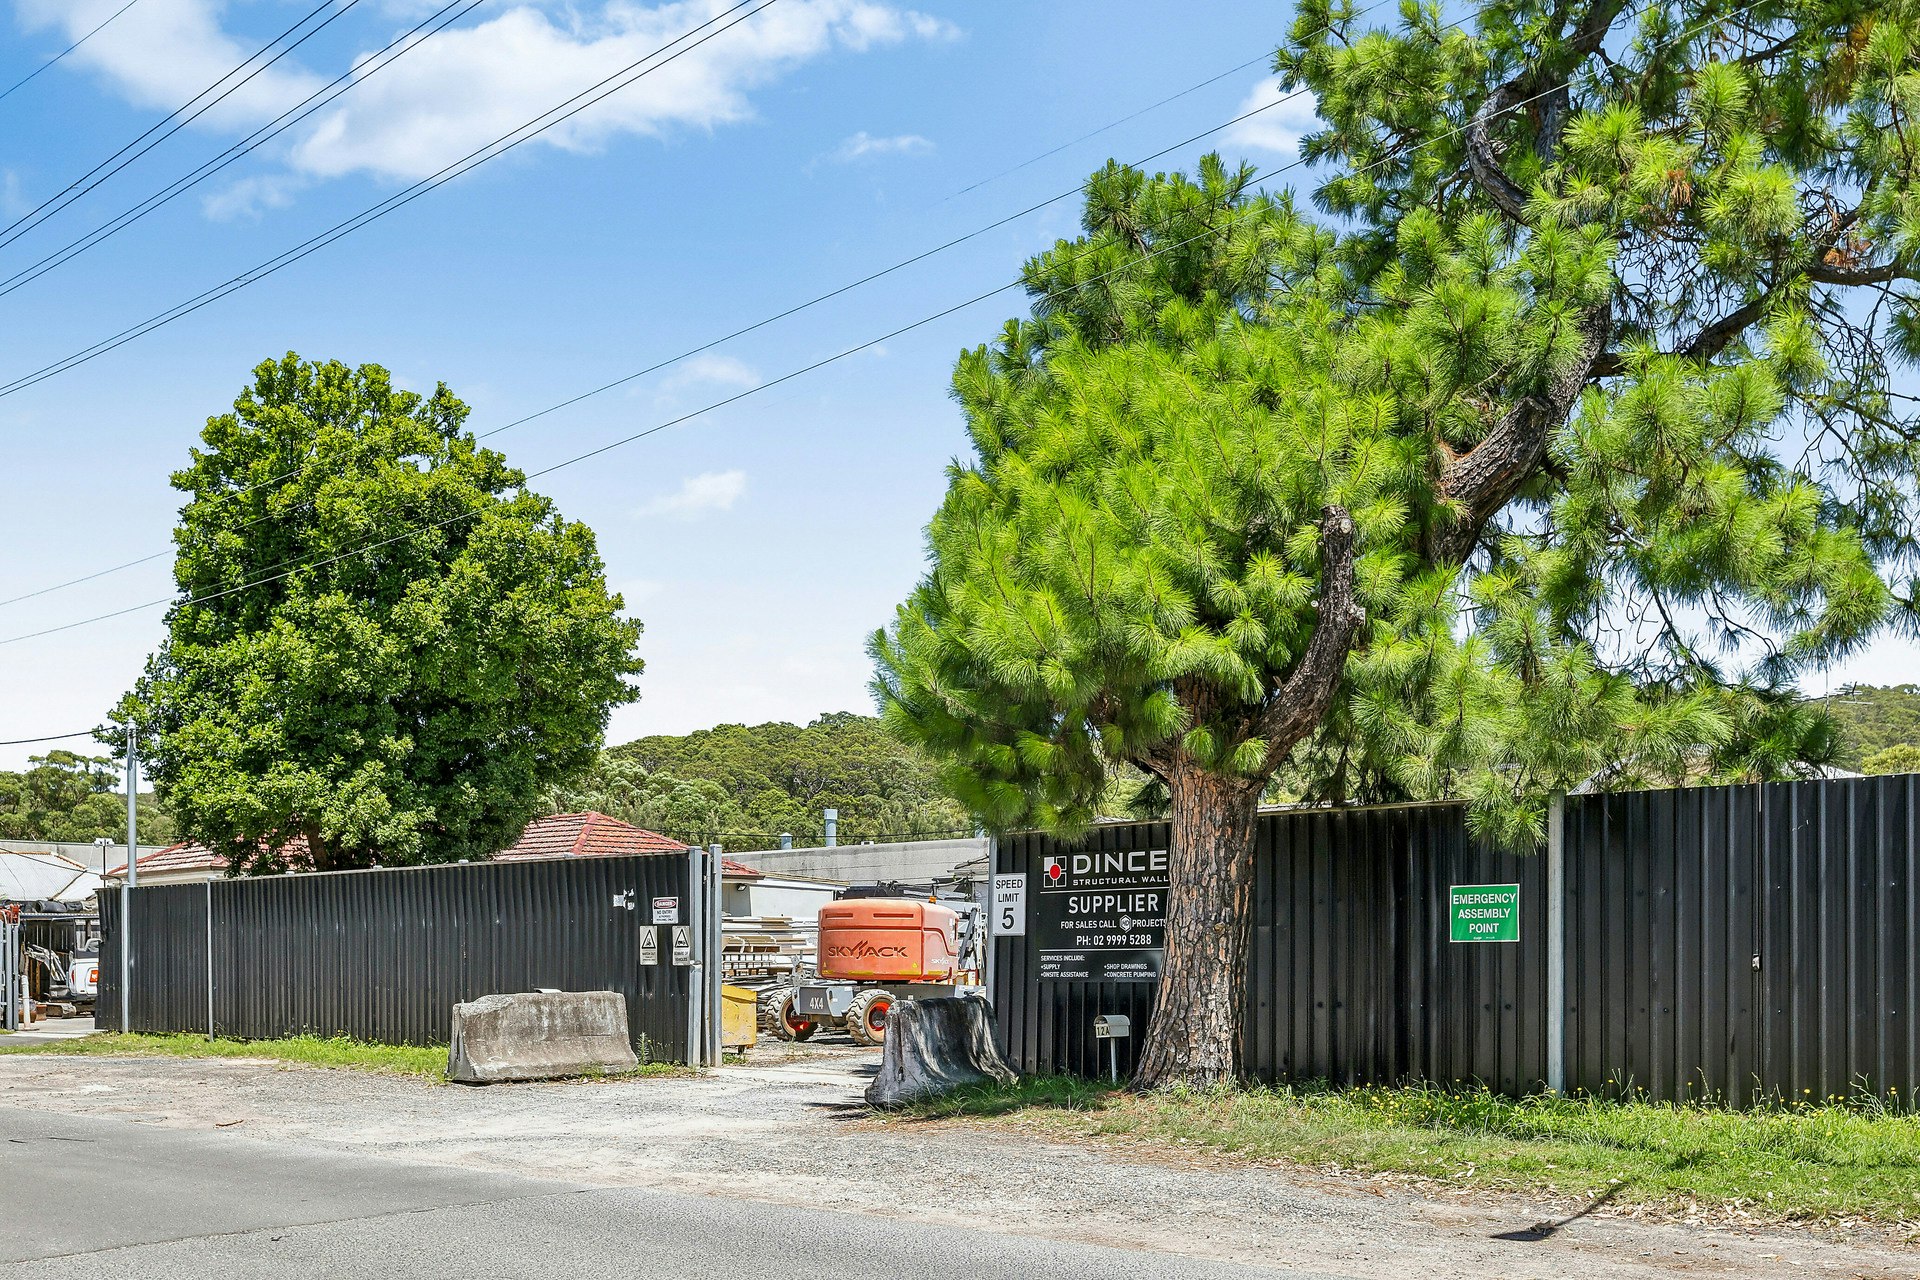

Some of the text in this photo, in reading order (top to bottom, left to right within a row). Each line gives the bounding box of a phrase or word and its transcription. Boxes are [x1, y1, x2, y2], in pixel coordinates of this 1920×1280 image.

[1072, 850, 1167, 875] DINCE
[996, 879, 1024, 890] SPEED
[1073, 876, 1138, 886] STRUCTURAL
[998, 892, 1020, 902] LIMIT
[1453, 893, 1516, 905] EMERGENCY
[1068, 894, 1158, 914] SUPPLIER
[1002, 907, 1014, 930] 5
[1458, 908, 1511, 919] ASSEMBLY
[1060, 921, 1074, 930] FOR
[1076, 920, 1098, 928] SALES
[1098, 920, 1116, 928] CALL
[1469, 923, 1500, 934] POINT
[1076, 934, 1152, 946] PH: 02 9999 5288
[828, 940, 909, 960] SKYJACK
[810, 997, 824, 1010] 4X4
[1097, 1026, 1110, 1036] 12A
